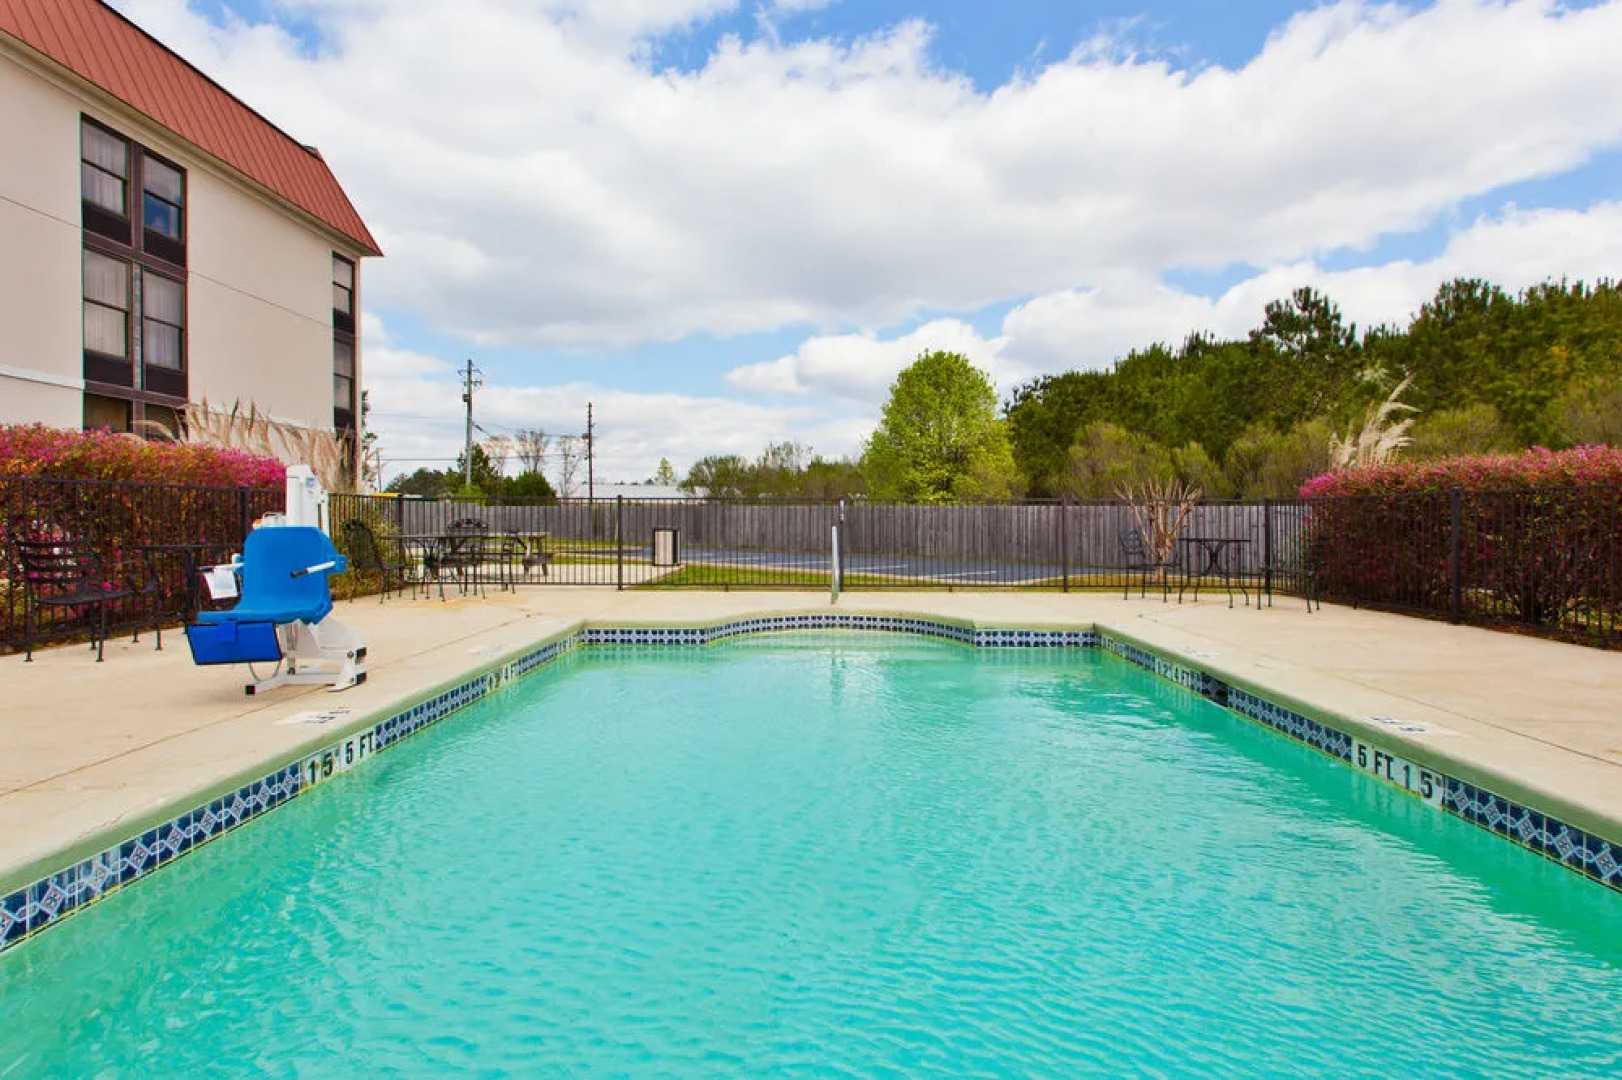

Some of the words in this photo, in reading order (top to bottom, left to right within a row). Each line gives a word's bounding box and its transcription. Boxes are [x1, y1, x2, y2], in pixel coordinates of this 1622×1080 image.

[345, 740, 354, 765] 5
[359, 731, 375, 759] FT
[1357, 743, 1367, 768] 5
